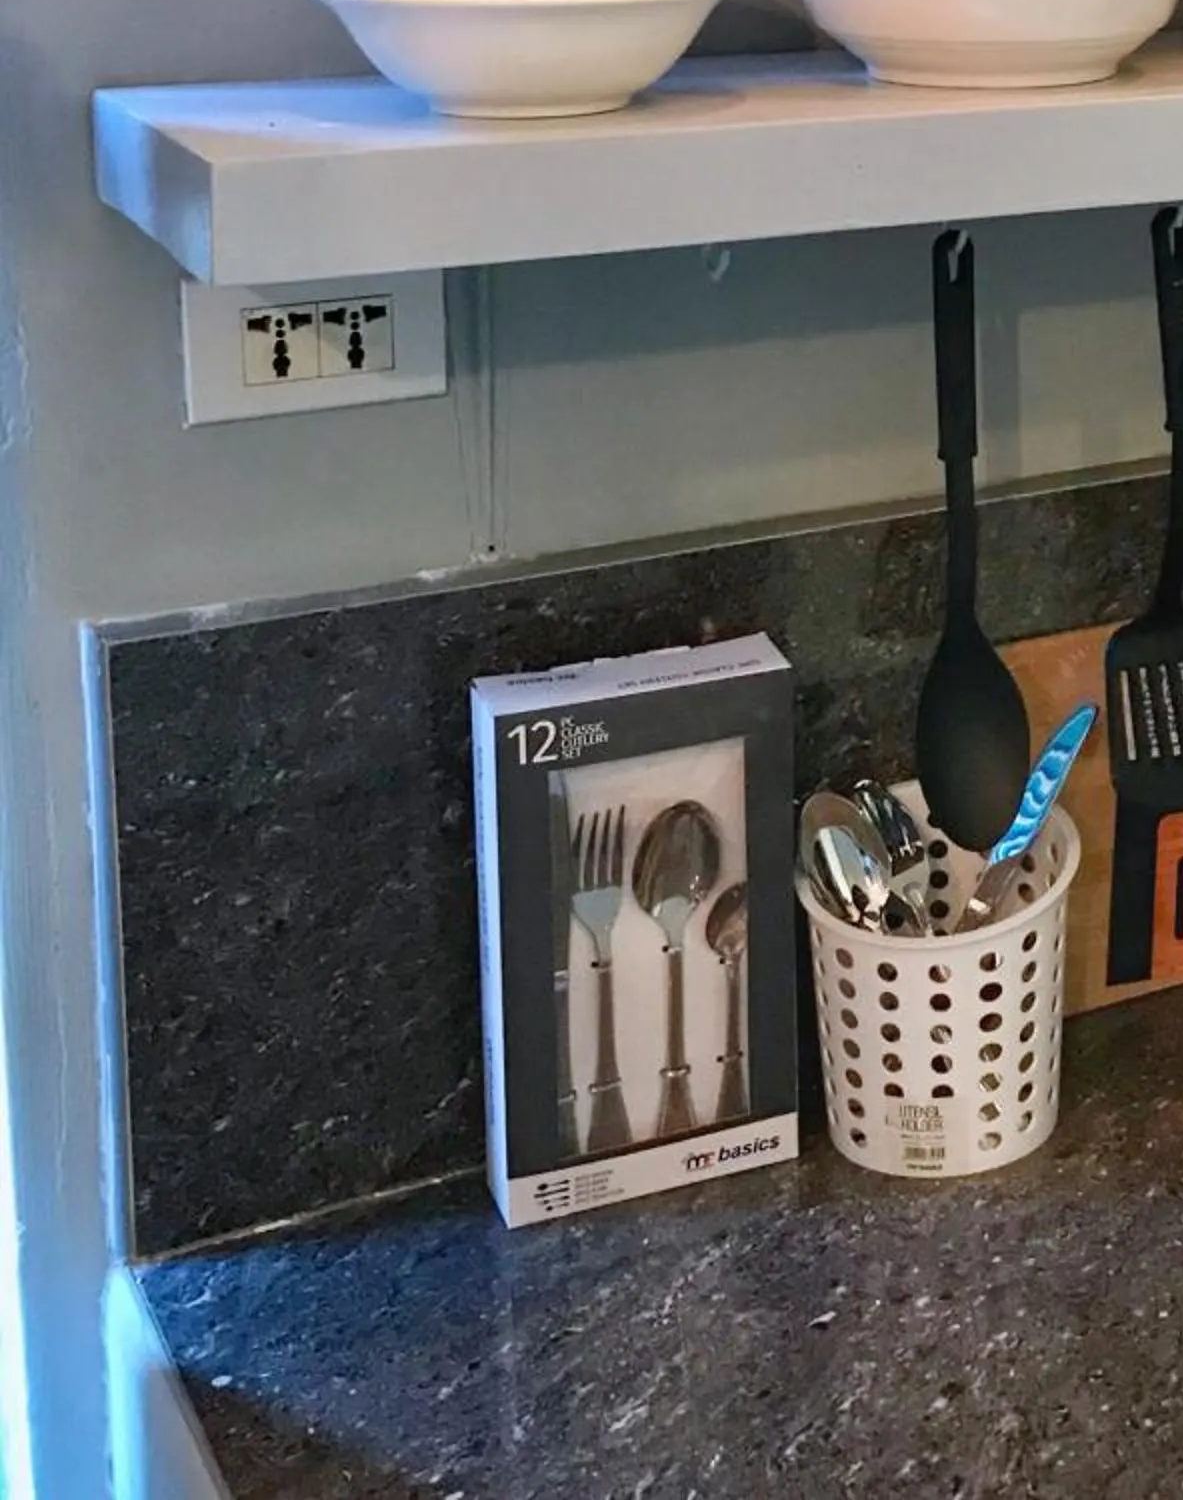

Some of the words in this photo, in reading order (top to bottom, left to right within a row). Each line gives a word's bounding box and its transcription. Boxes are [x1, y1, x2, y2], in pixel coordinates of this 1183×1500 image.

[561, 721, 605, 737] CLASSIC
[507, 719, 559, 765] 12
[561, 732, 610, 749] CUTLERY
[561, 746, 581, 759] SET
[717, 1135, 780, 1162] basics
